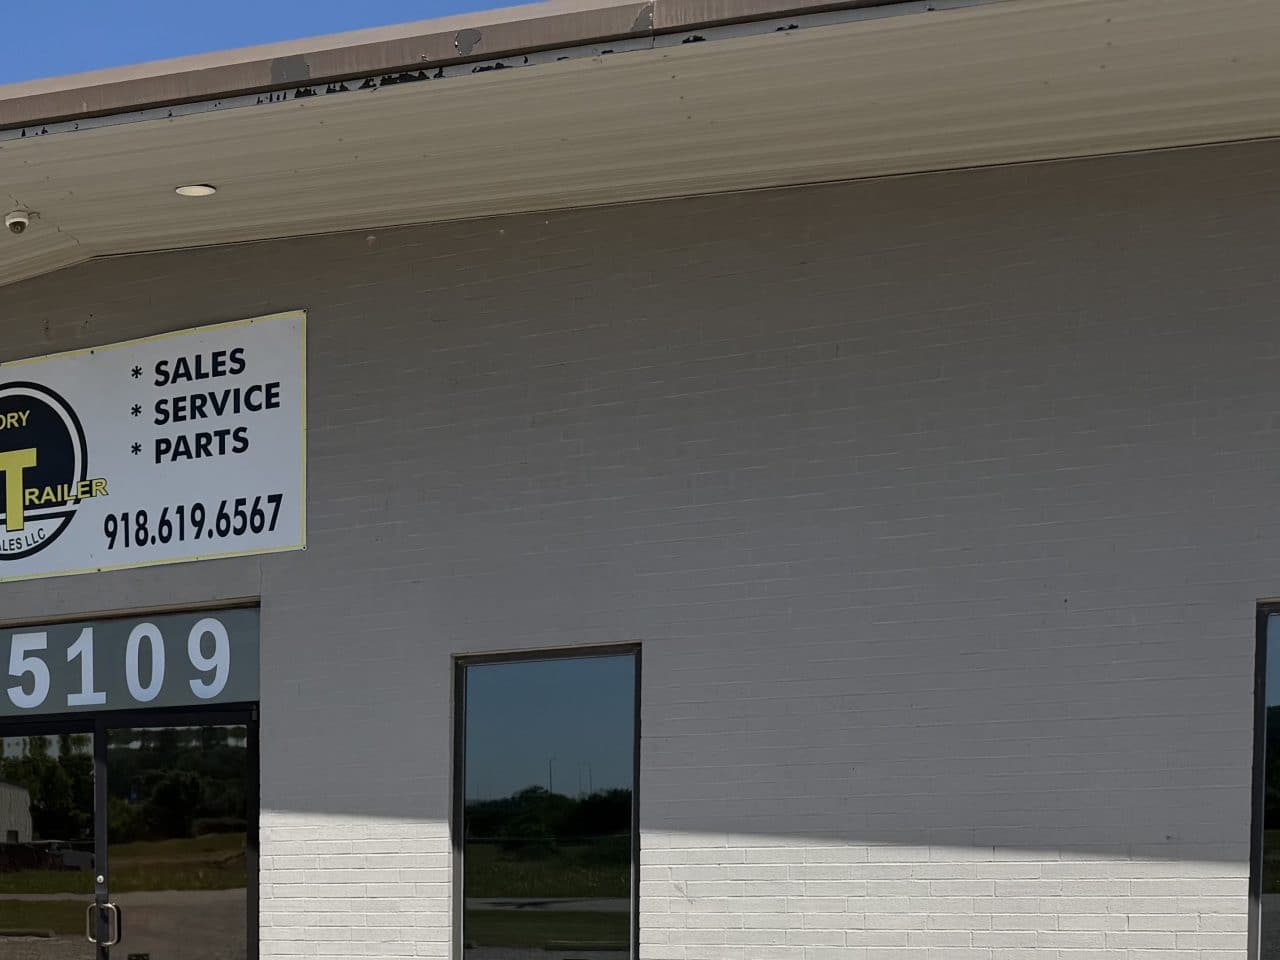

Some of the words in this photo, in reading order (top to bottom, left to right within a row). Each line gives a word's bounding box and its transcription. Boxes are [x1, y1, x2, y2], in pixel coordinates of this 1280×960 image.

[154, 347, 246, 387] SALES
[154, 381, 280, 426] SERVICE
[154, 426, 250, 464] PARTS
[25, 527, 46, 547] LLC
[103, 493, 283, 550] 918.619.6567
[6, 617, 231, 710] 5109
